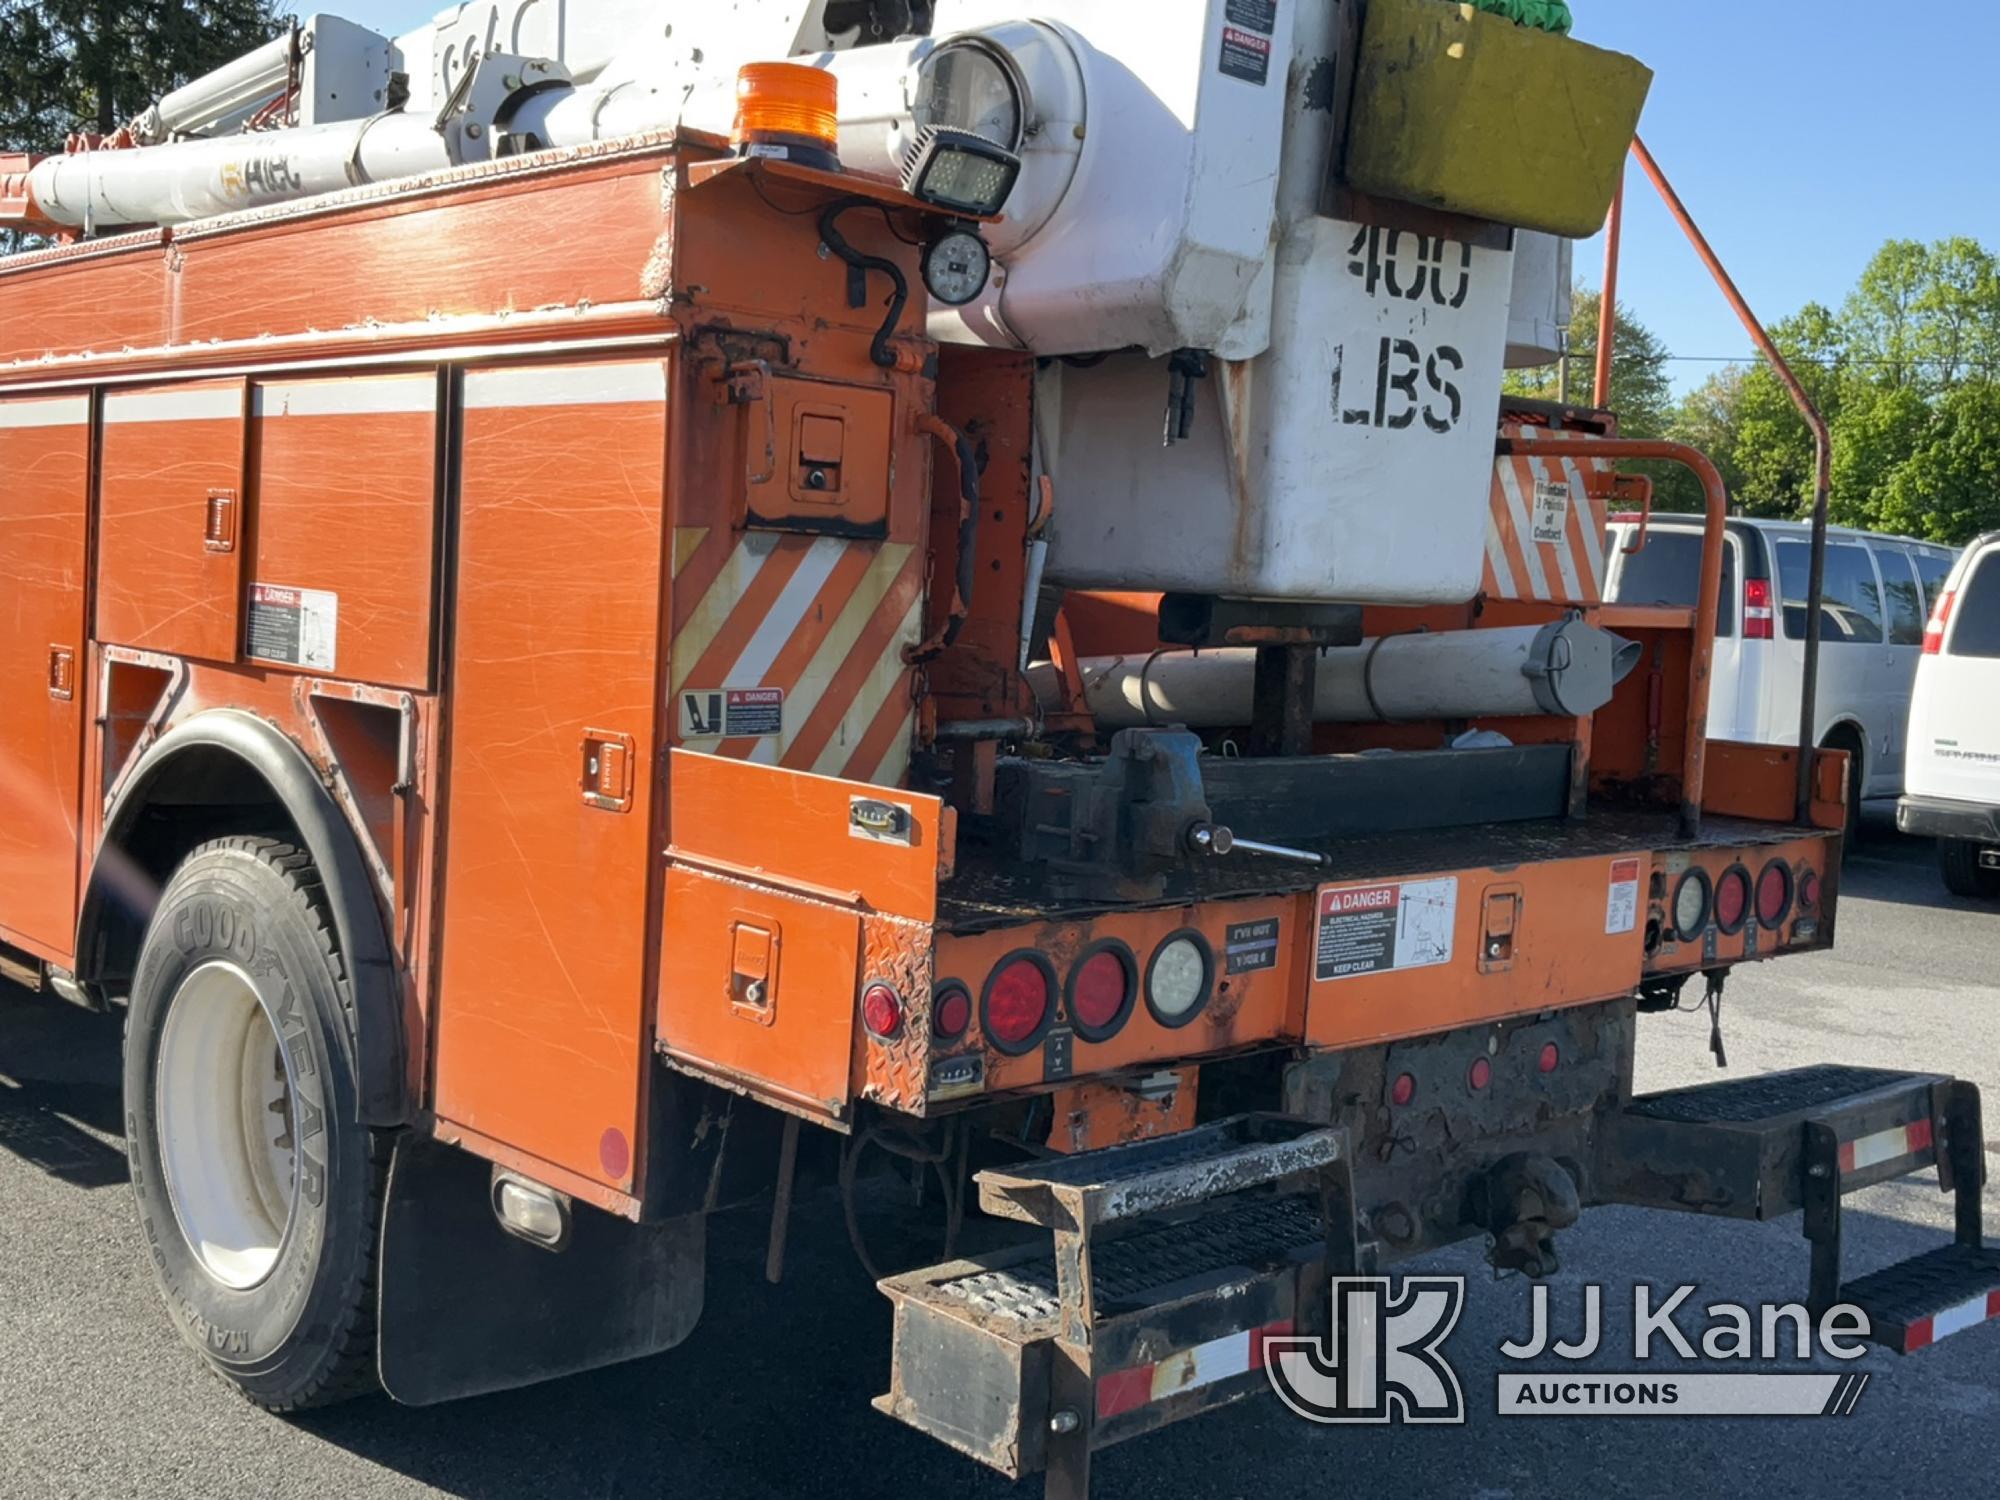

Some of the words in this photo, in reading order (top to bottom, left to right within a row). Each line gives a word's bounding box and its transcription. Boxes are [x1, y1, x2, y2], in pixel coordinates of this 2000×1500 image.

[1348, 225, 1472, 309] 400
[1330, 336, 1464, 434] LBS
[1534, 526, 1562, 540] Contact
[744, 691, 778, 702] DANGER
[1343, 890, 1391, 909] DANGER
[1333, 963, 1352, 974] KEEP
[1352, 960, 1375, 971] CLEAR
